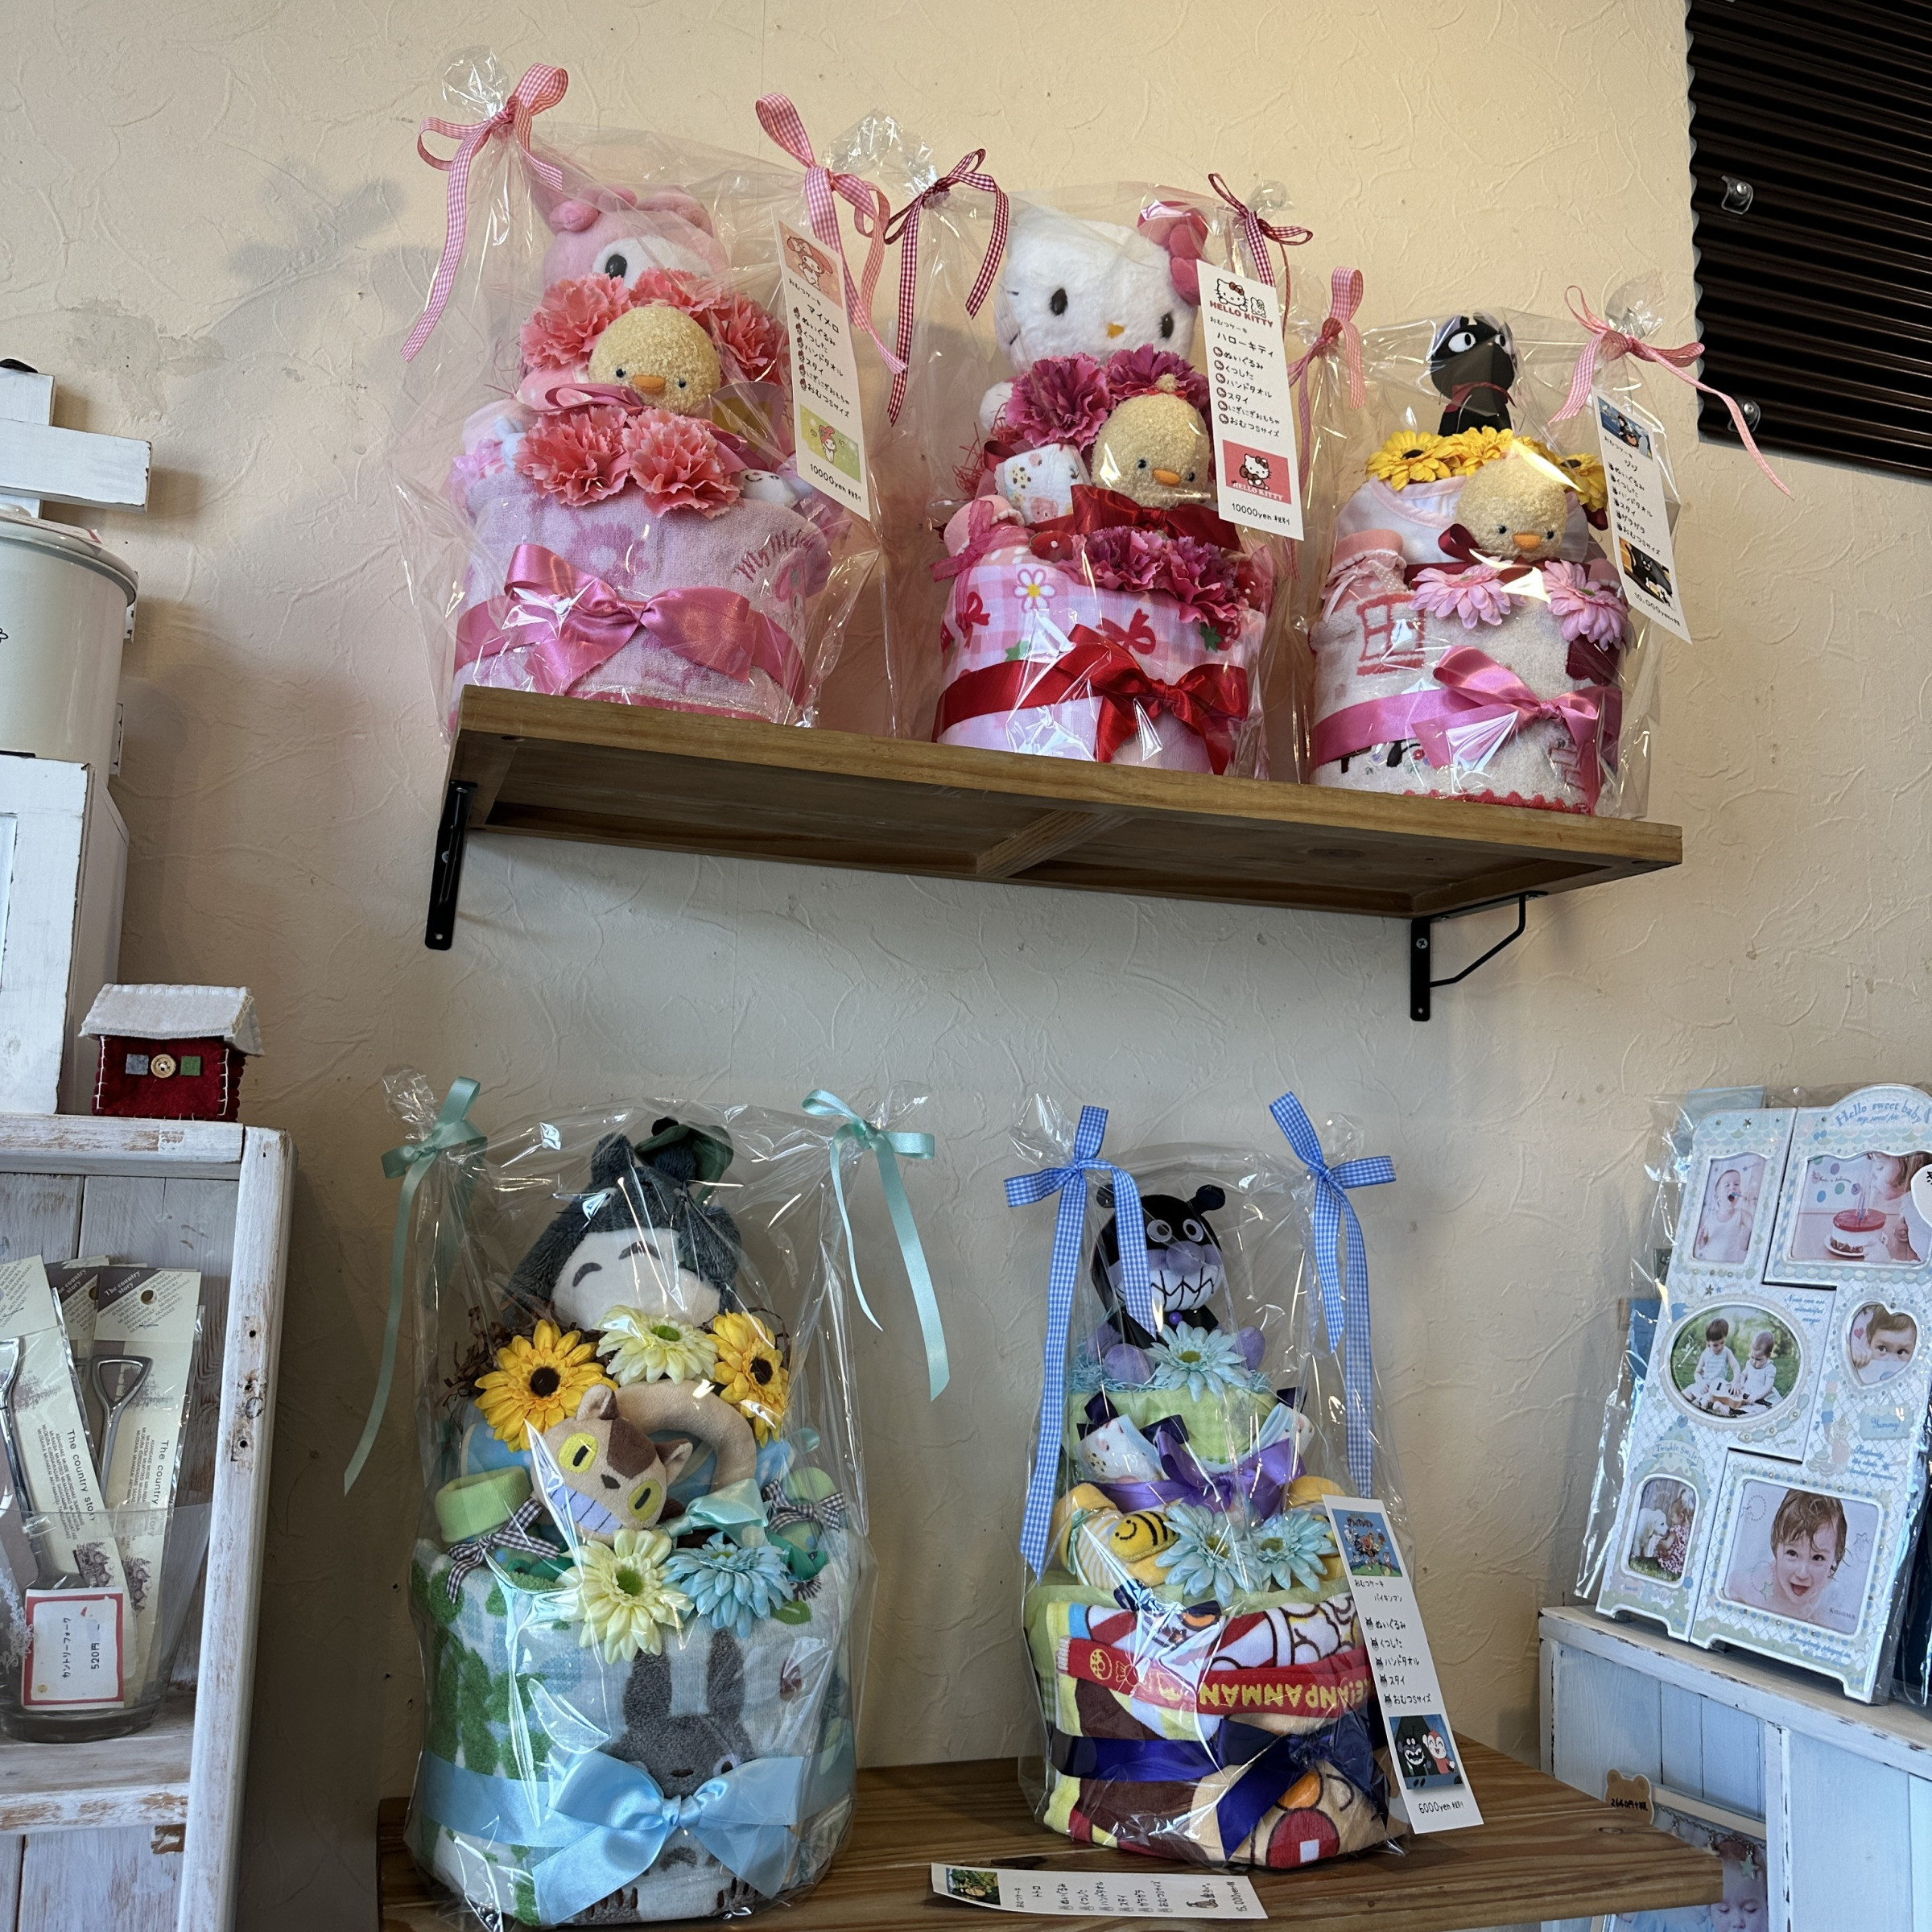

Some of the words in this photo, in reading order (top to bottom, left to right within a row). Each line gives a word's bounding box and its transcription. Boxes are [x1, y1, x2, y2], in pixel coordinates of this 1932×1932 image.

[807, 303, 840, 333] マイメロ
[1209, 299, 1241, 318] HELLO
[1244, 312, 1274, 328] KITTY
[803, 317, 836, 346] ぬいぐるみ
[1210, 316, 1248, 333] おむつケーキ
[803, 331, 828, 353] くつした
[1216, 332, 1274, 357] ハローキティ
[806, 357, 824, 376] スタイ
[1224, 350, 1264, 370] ぬいぐるみ
[1225, 365, 1254, 381] くつした
[1226, 377, 1273, 398] ハンドタオル
[1227, 391, 1249, 405] スタイ
[1228, 404, 1280, 425] にぎにぎおもちゃ
[1230, 416, 1280, 438] おむつSサイズ
[809, 463, 847, 494] 10000yen
[1258, 489, 1283, 501] KITTY
[1232, 502, 1273, 521] 10000yen
[1835, 1102, 1868, 1127] Hello
[1872, 1102, 1899, 1110] sweet
[159, 1440, 169, 1459] The
[67, 1428, 76, 1450] The
[72, 1454, 89, 1492] country
[151, 1465, 163, 1505] country
[1354, 1579, 1385, 1588] おむつケーキ
[1375, 1618, 1406, 1630] ぬいぐるみ
[62, 1617, 72, 1678] カントリーフォーク
[1380, 1637, 1403, 1649] くつした
[90, 1642, 100, 1670] 520円
[1385, 1654, 1420, 1668] ハンドタオル
[1389, 1675, 1406, 1686] スタイ
[1393, 1693, 1432, 1705] おむつSサイズ
[1418, 1801, 1451, 1814] 6000yen
[1031, 1886, 1042, 1897] トトロ
